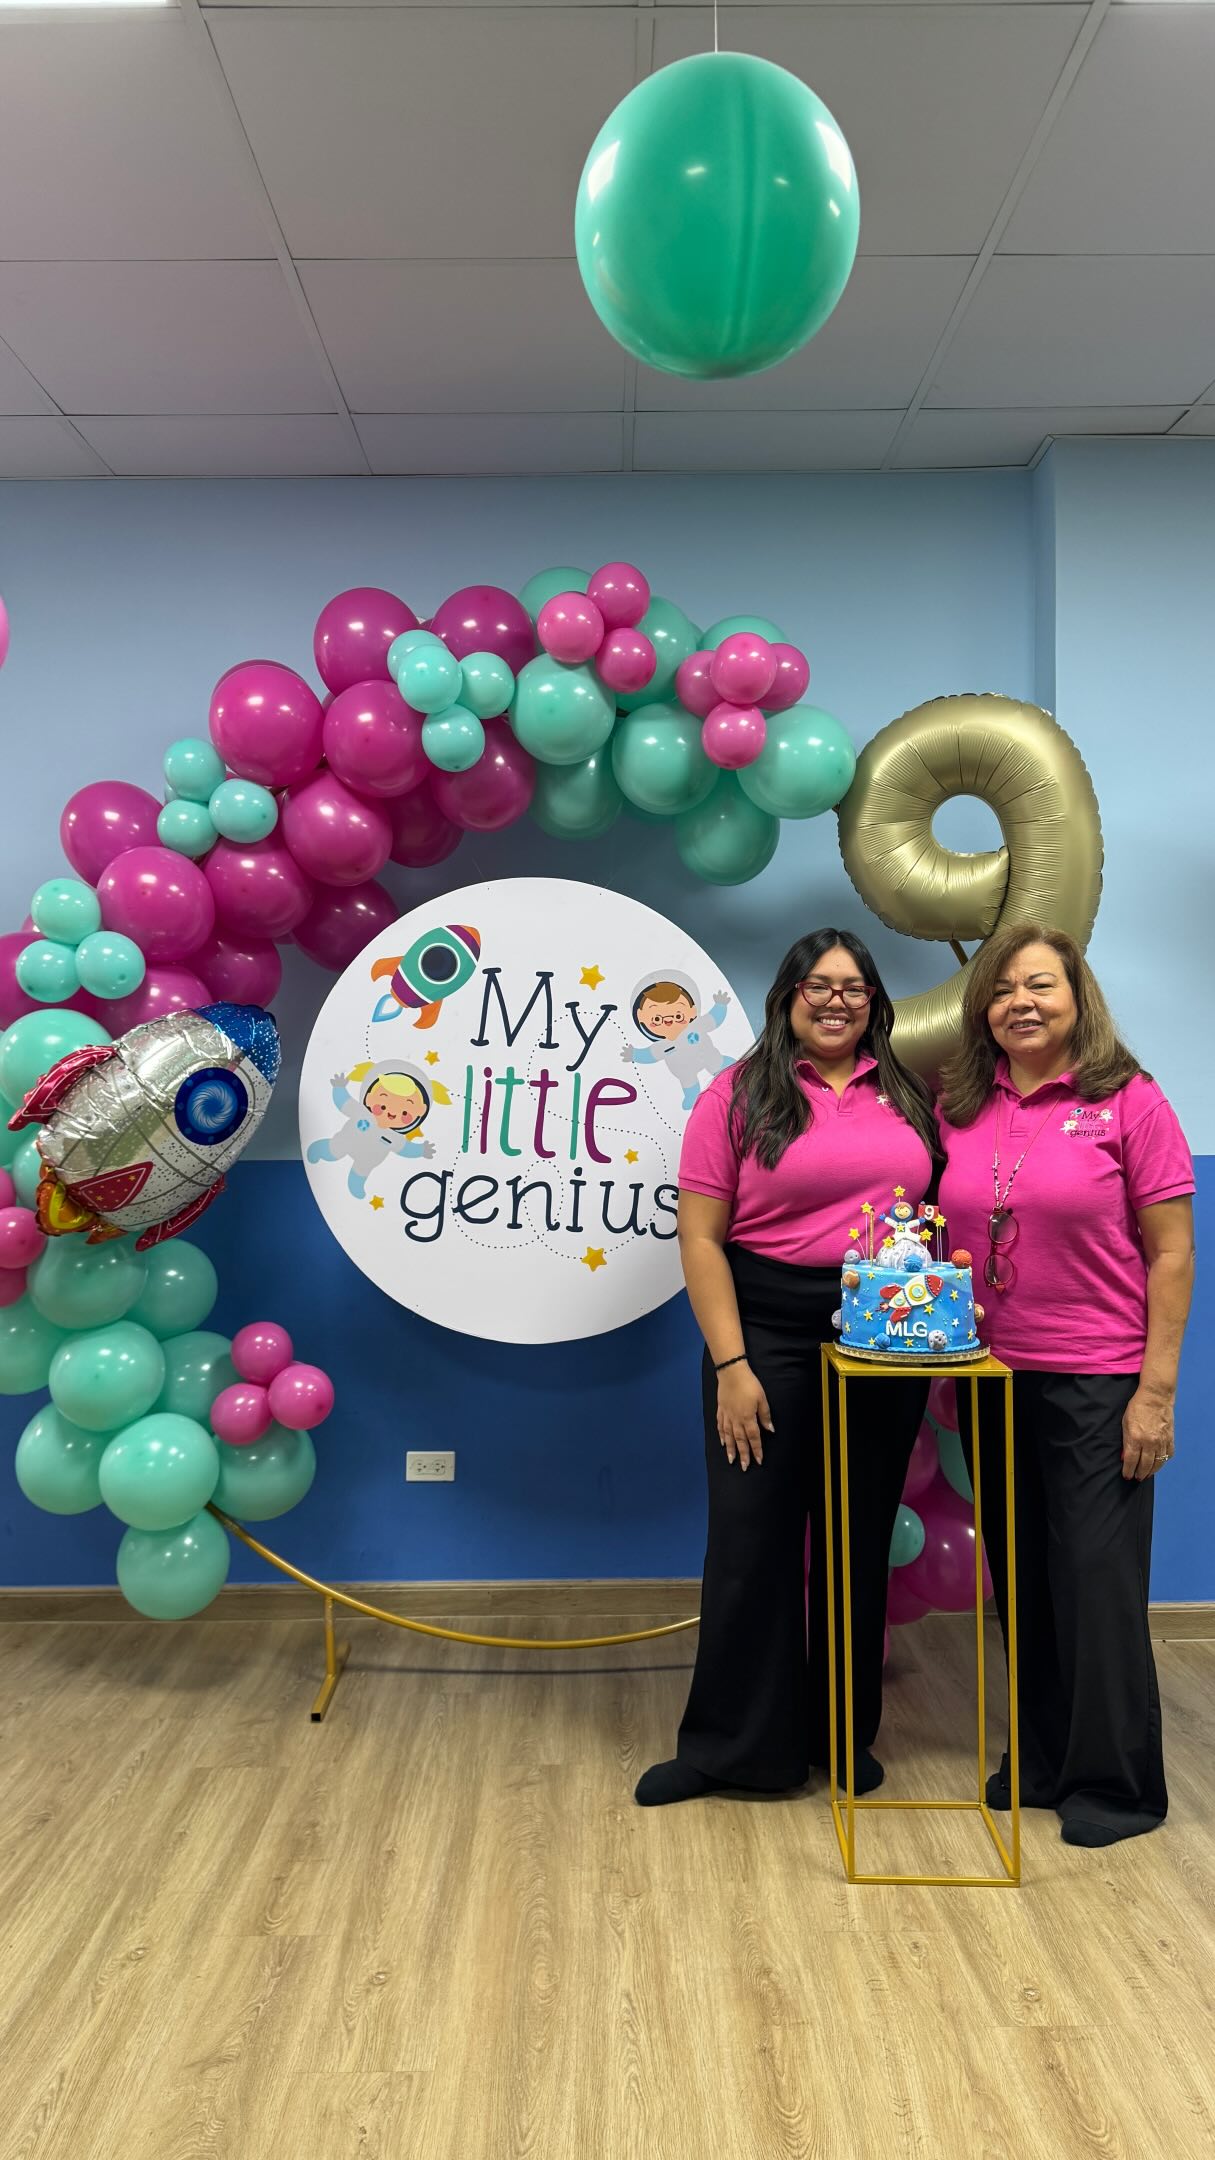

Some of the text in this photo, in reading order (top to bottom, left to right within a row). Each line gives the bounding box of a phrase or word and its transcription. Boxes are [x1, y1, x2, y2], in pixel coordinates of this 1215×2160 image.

[470, 967, 618, 1072] My
[461, 1064, 638, 1163] little
[1081, 1110, 1100, 1121] My
[400, 1167, 679, 1243] genius
[924, 1205, 935, 1220] 9
[886, 1320, 928, 1337] MLG
